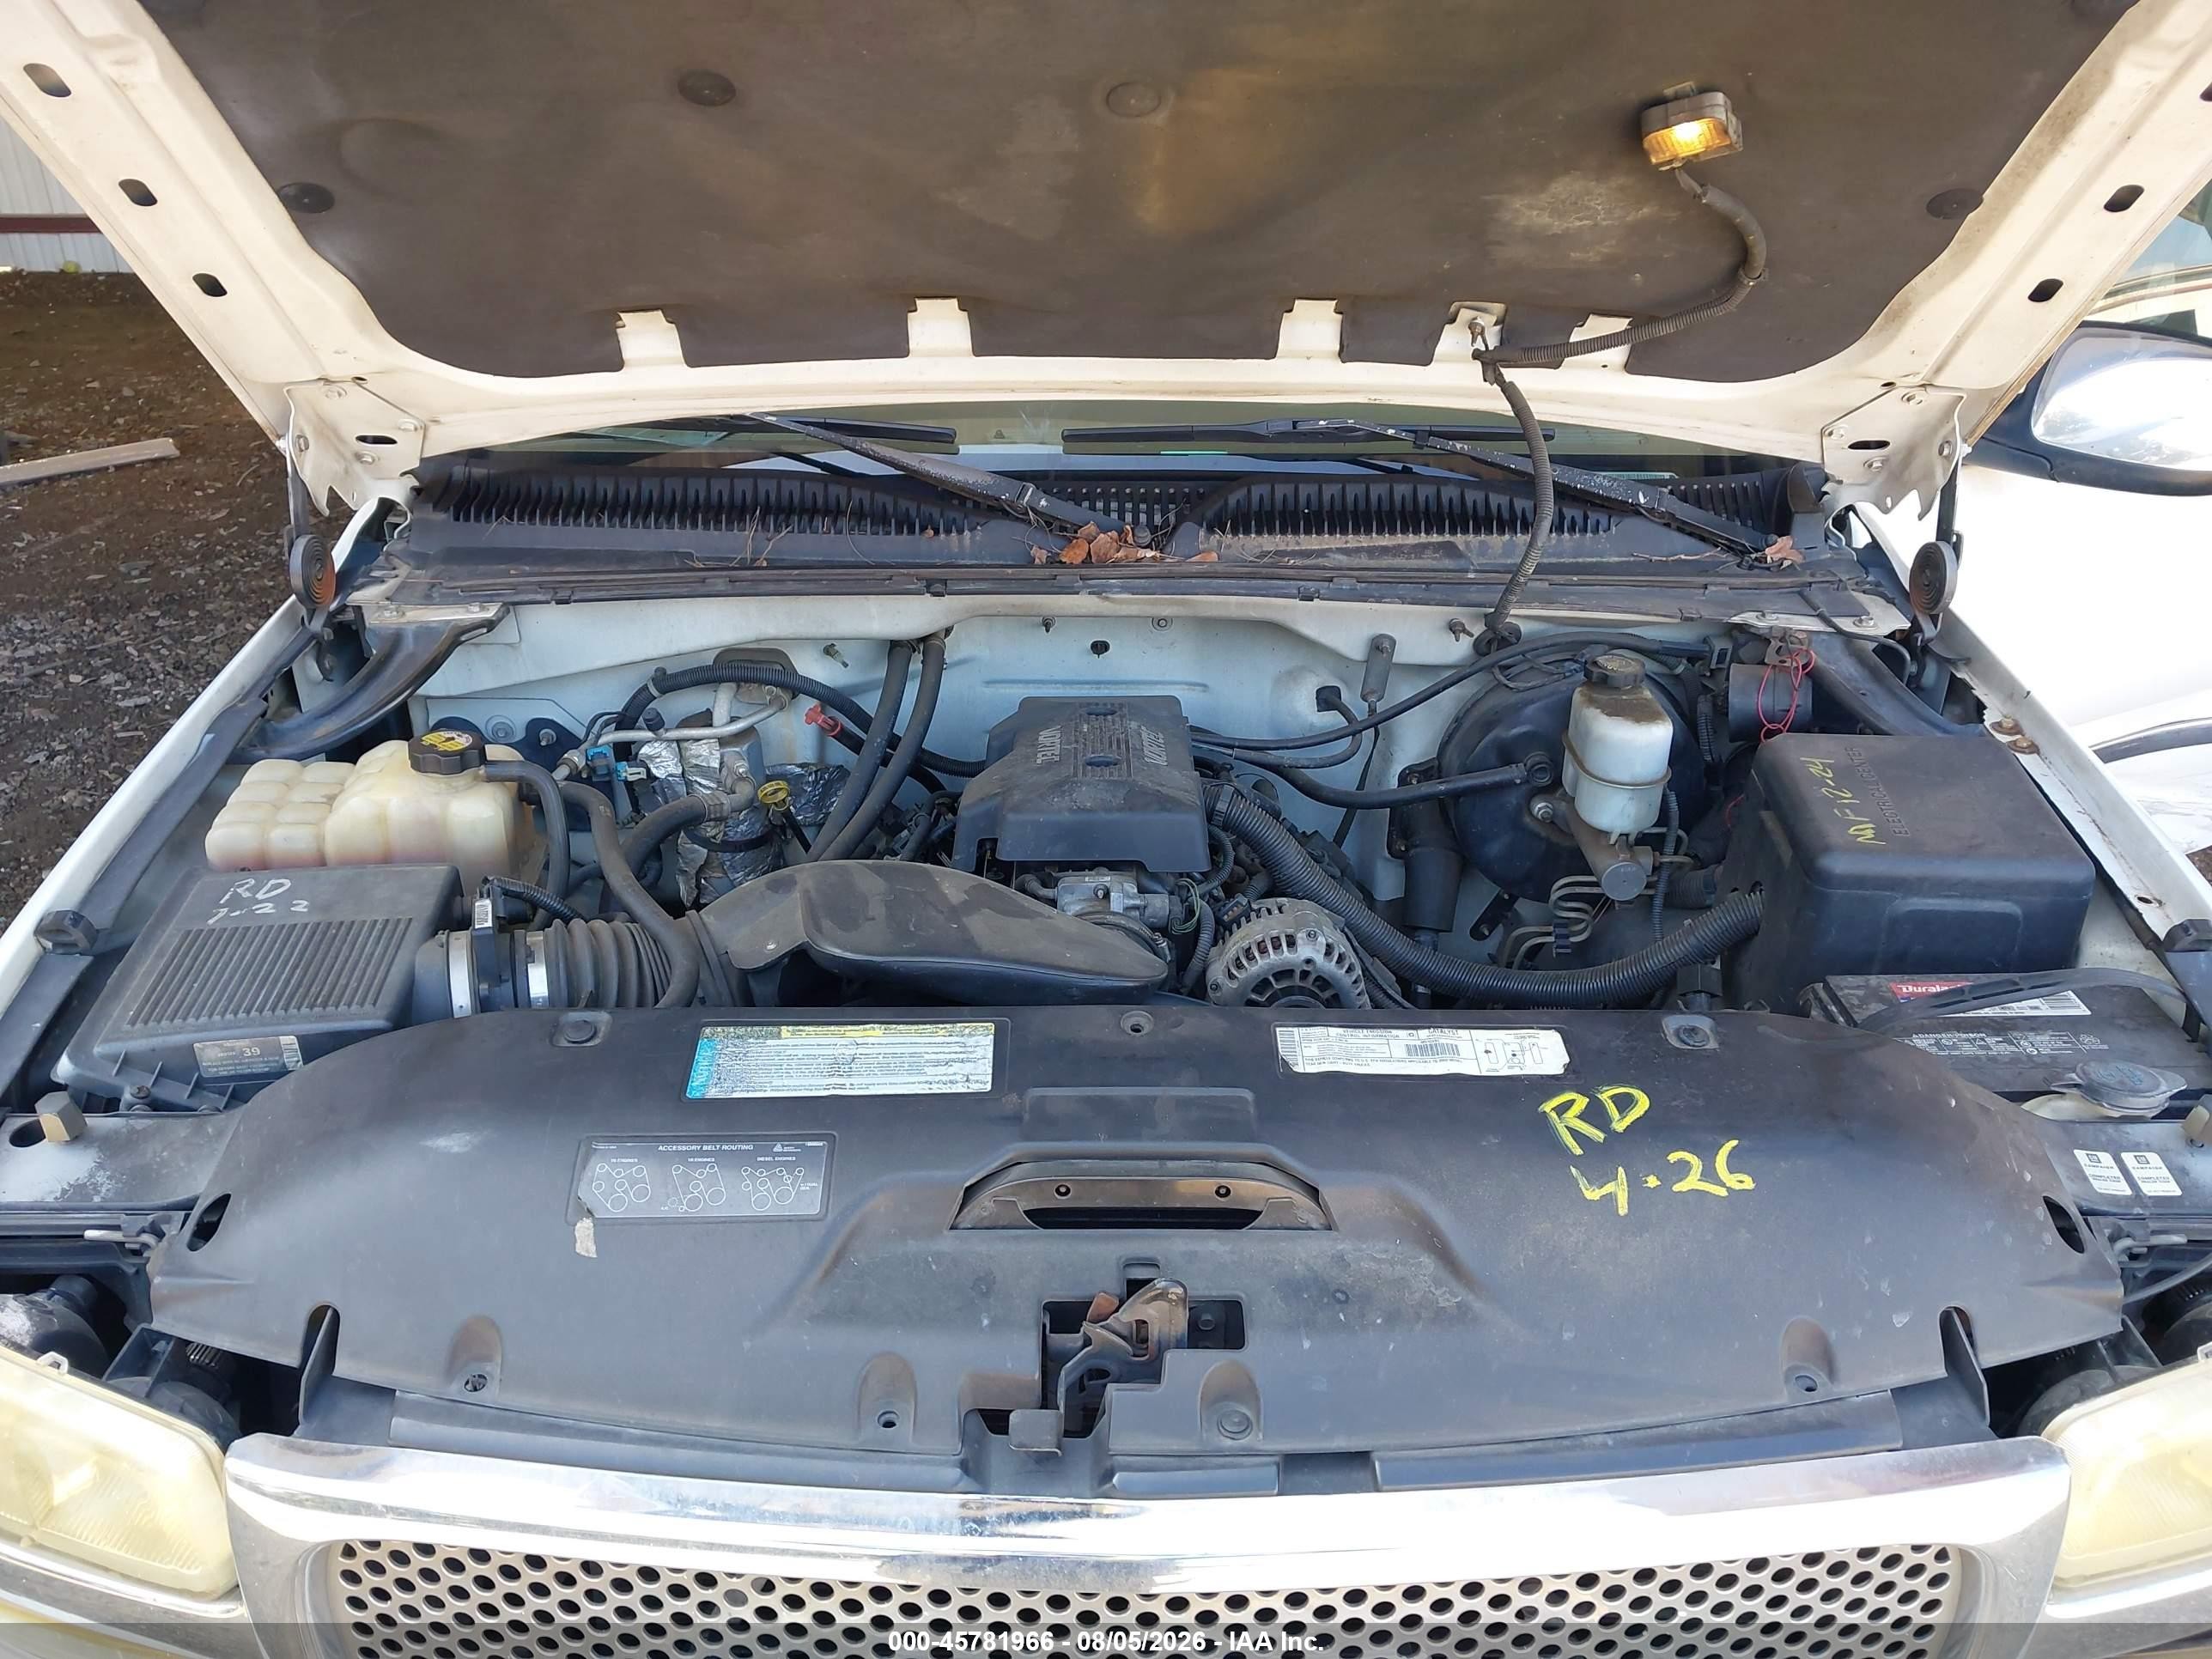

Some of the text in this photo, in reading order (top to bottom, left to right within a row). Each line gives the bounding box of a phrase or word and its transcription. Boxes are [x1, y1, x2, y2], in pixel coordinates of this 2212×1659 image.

[1844, 746, 1910, 836] ELECTRICAL CENTER
[219, 878, 292, 904] RD
[242, 1047, 261, 1057] 39
[1538, 1084, 1650, 1156] RD
